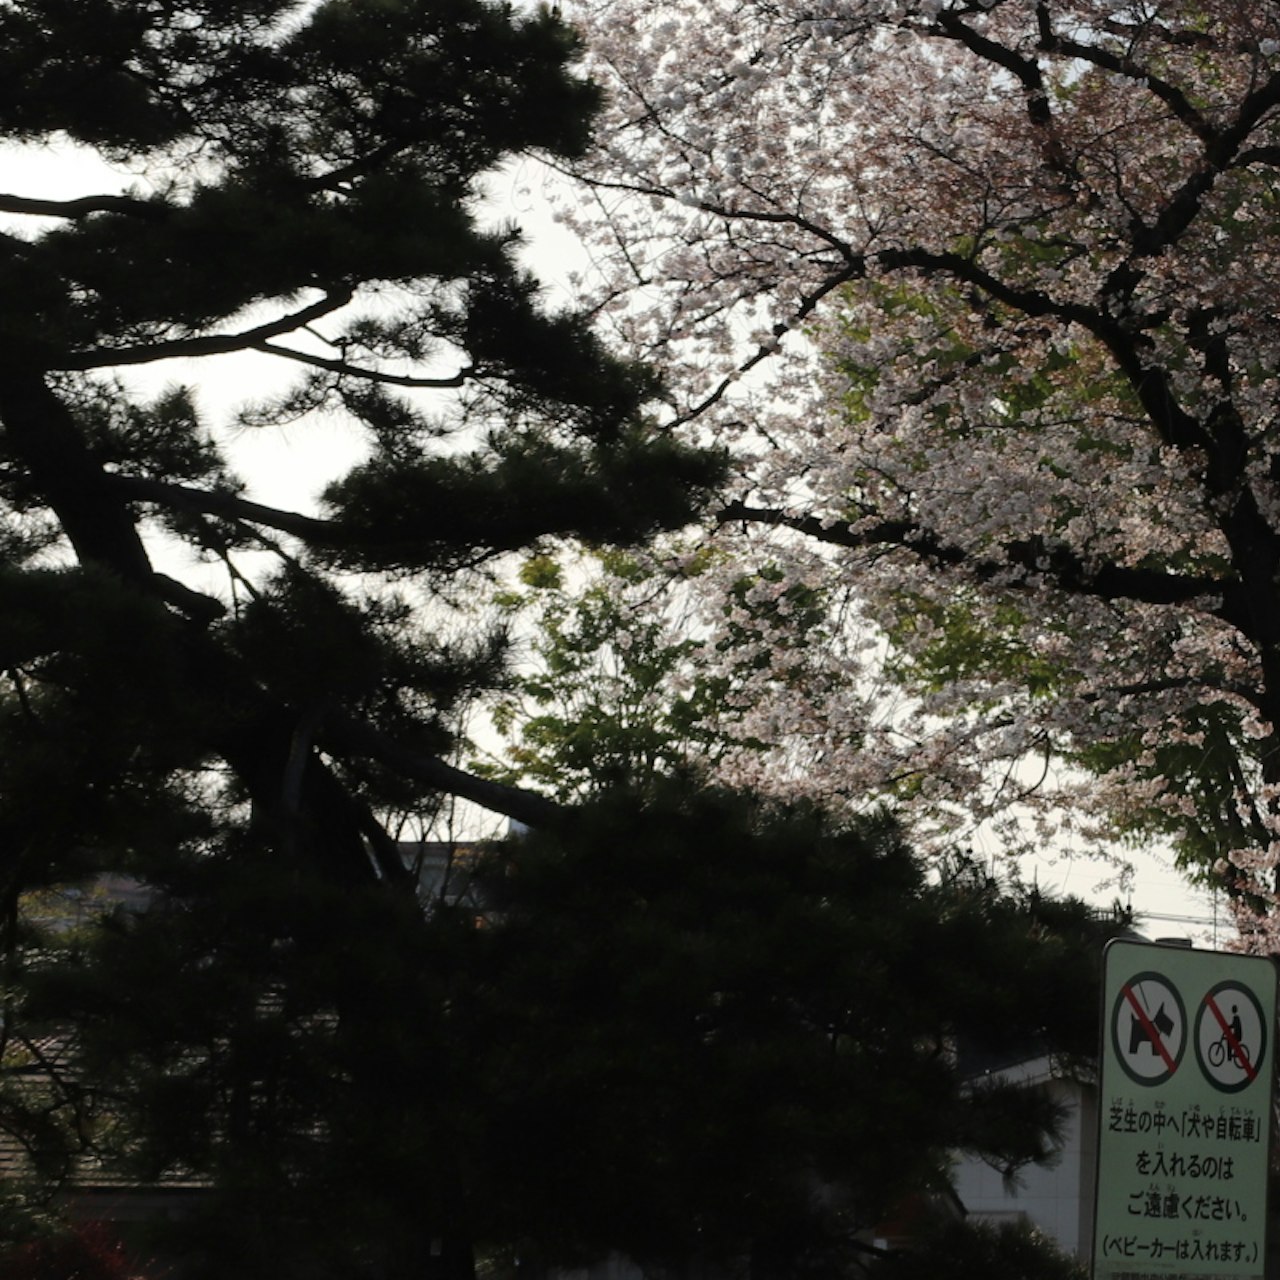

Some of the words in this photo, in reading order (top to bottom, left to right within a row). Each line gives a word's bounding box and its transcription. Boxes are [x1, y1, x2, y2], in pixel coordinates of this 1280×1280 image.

[1109, 1106, 1261, 1142] 芝生の中へ「犬や自転車」
[1136, 1150, 1234, 1180] を入れるのは
[1128, 1191, 1247, 1222] ご遠慮ください。
[1103, 1235, 1259, 1263] （ベビーカーは入れます。）
